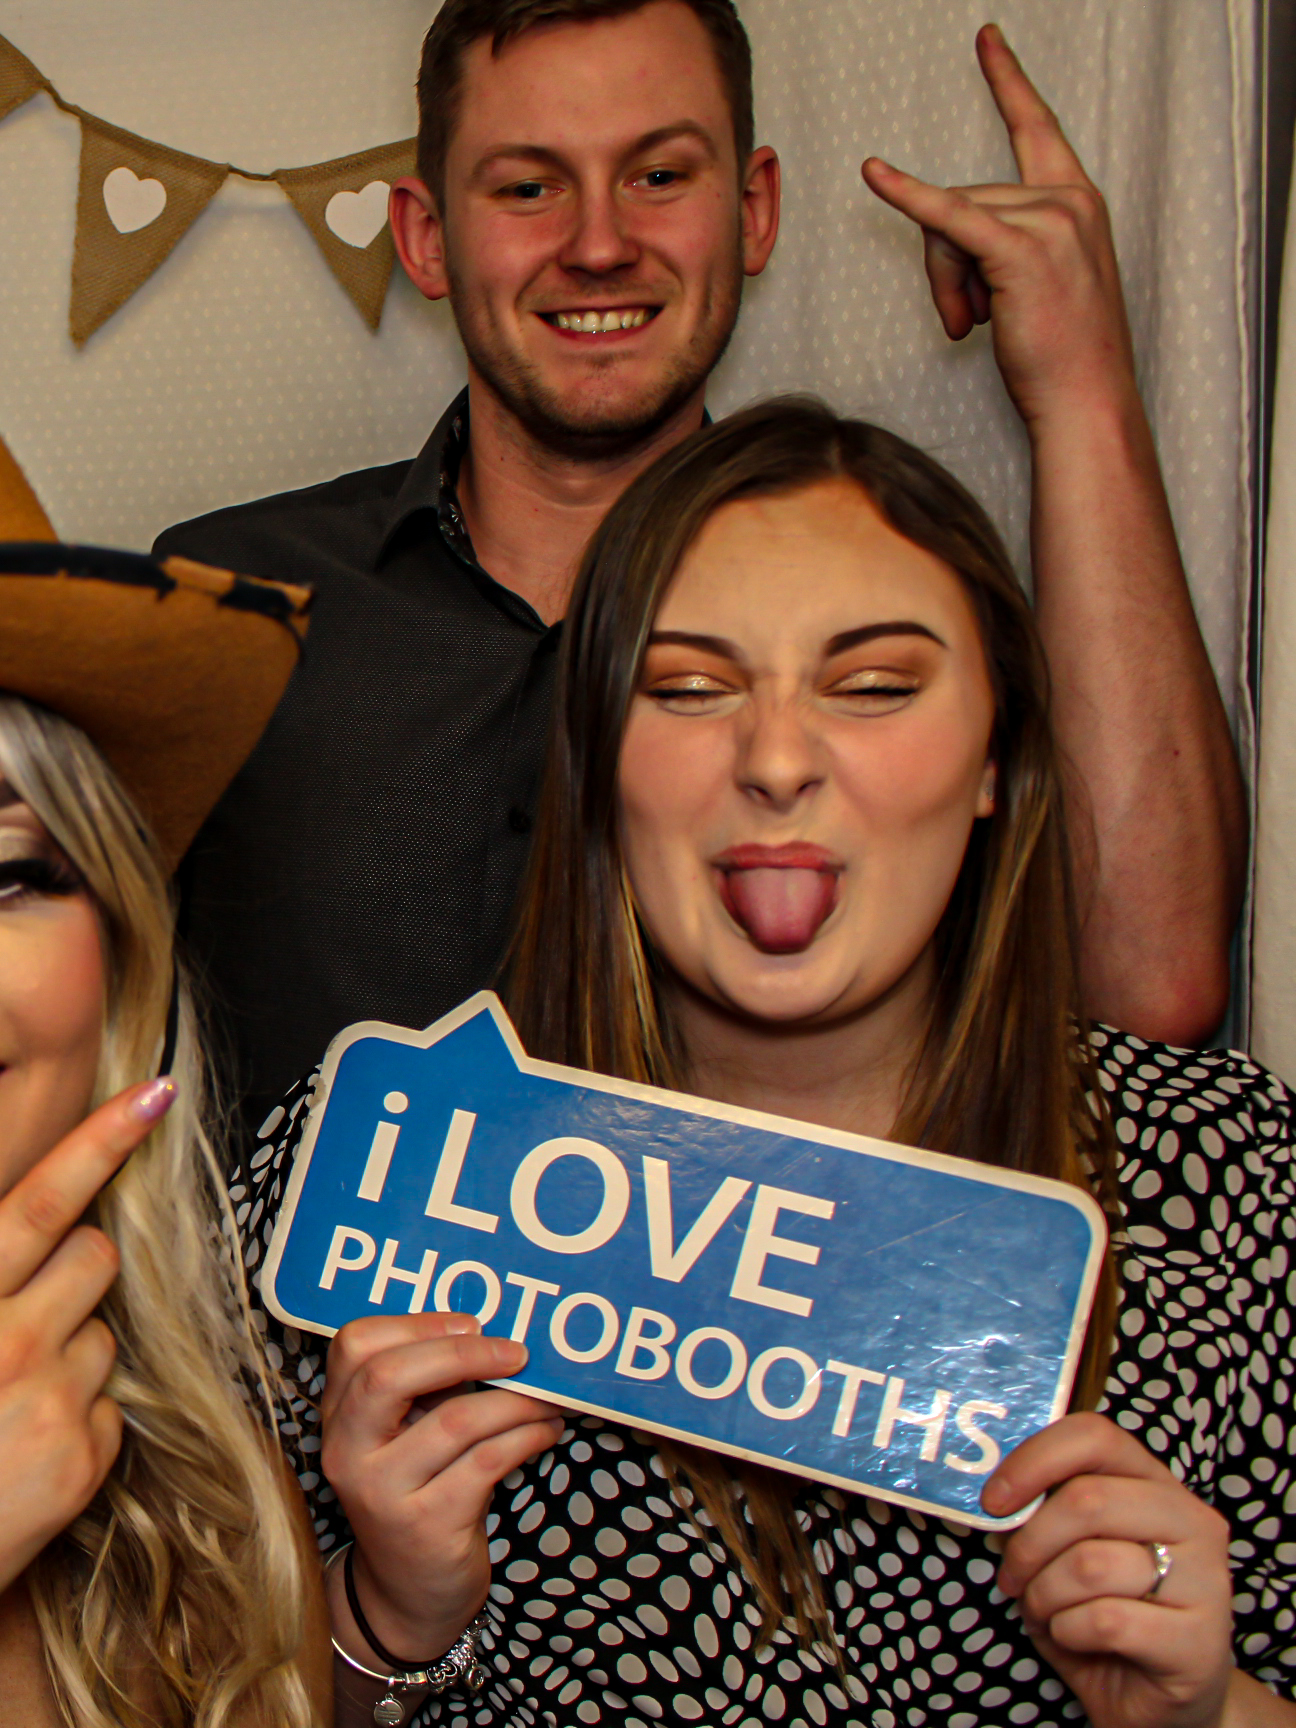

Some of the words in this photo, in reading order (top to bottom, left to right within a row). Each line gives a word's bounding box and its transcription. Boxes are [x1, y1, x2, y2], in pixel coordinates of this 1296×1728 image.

[357, 1091, 409, 1202] i
[424, 1108, 835, 1317] LOVE
[318, 1225, 1008, 1475] PHOTOBOOTHS
